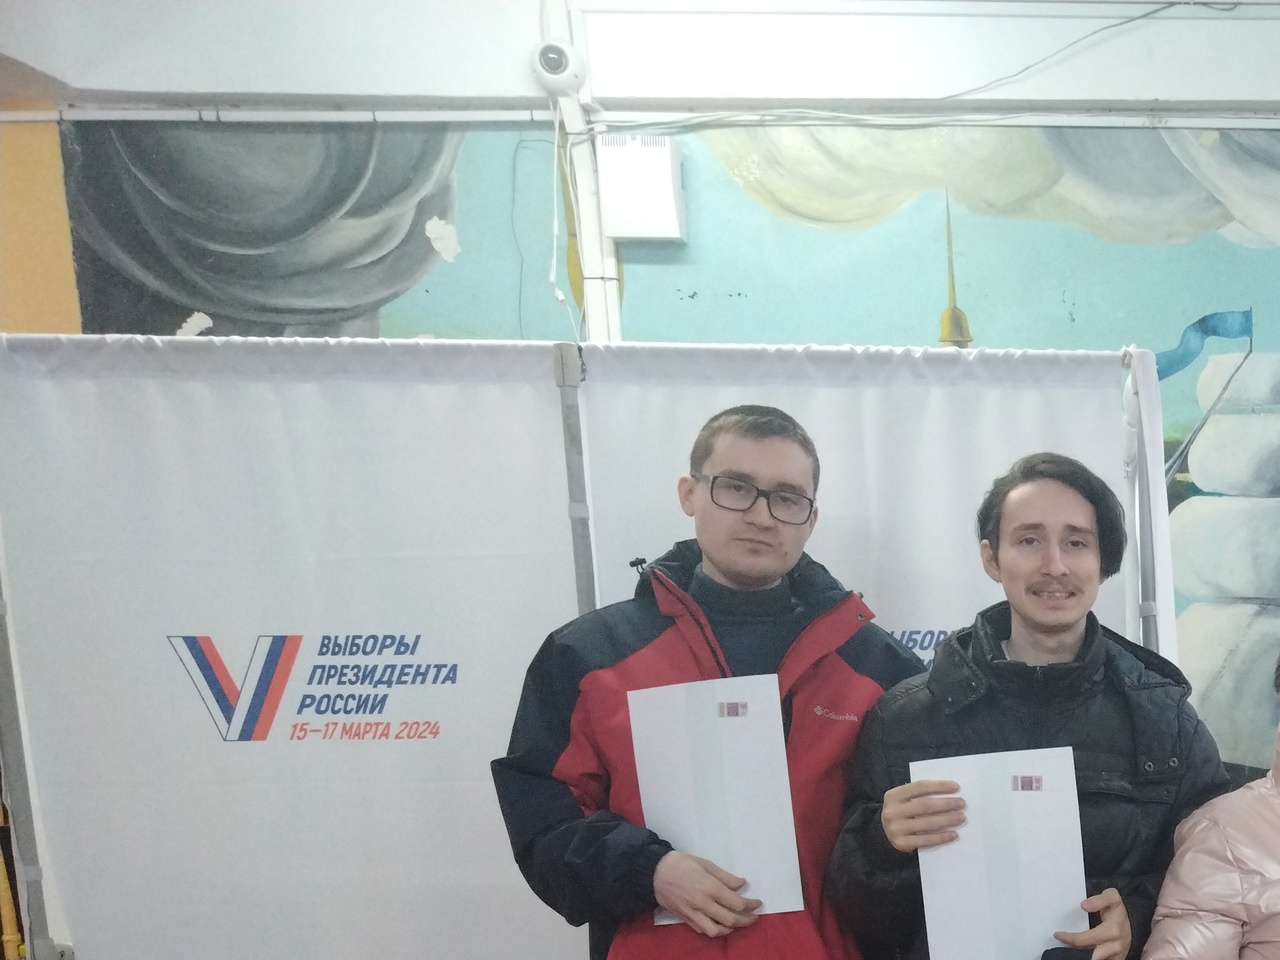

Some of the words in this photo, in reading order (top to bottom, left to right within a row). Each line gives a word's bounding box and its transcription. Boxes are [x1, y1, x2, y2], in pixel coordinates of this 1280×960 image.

[317, 634, 422, 656] ВЫБОРЫ
[306, 663, 459, 688] ПРЕЗИДЕНТА
[296, 693, 389, 715] РОССИИ
[823, 708, 859, 722] Columbia
[339, 721, 391, 740] МАРТА
[394, 720, 441, 740] 2024
